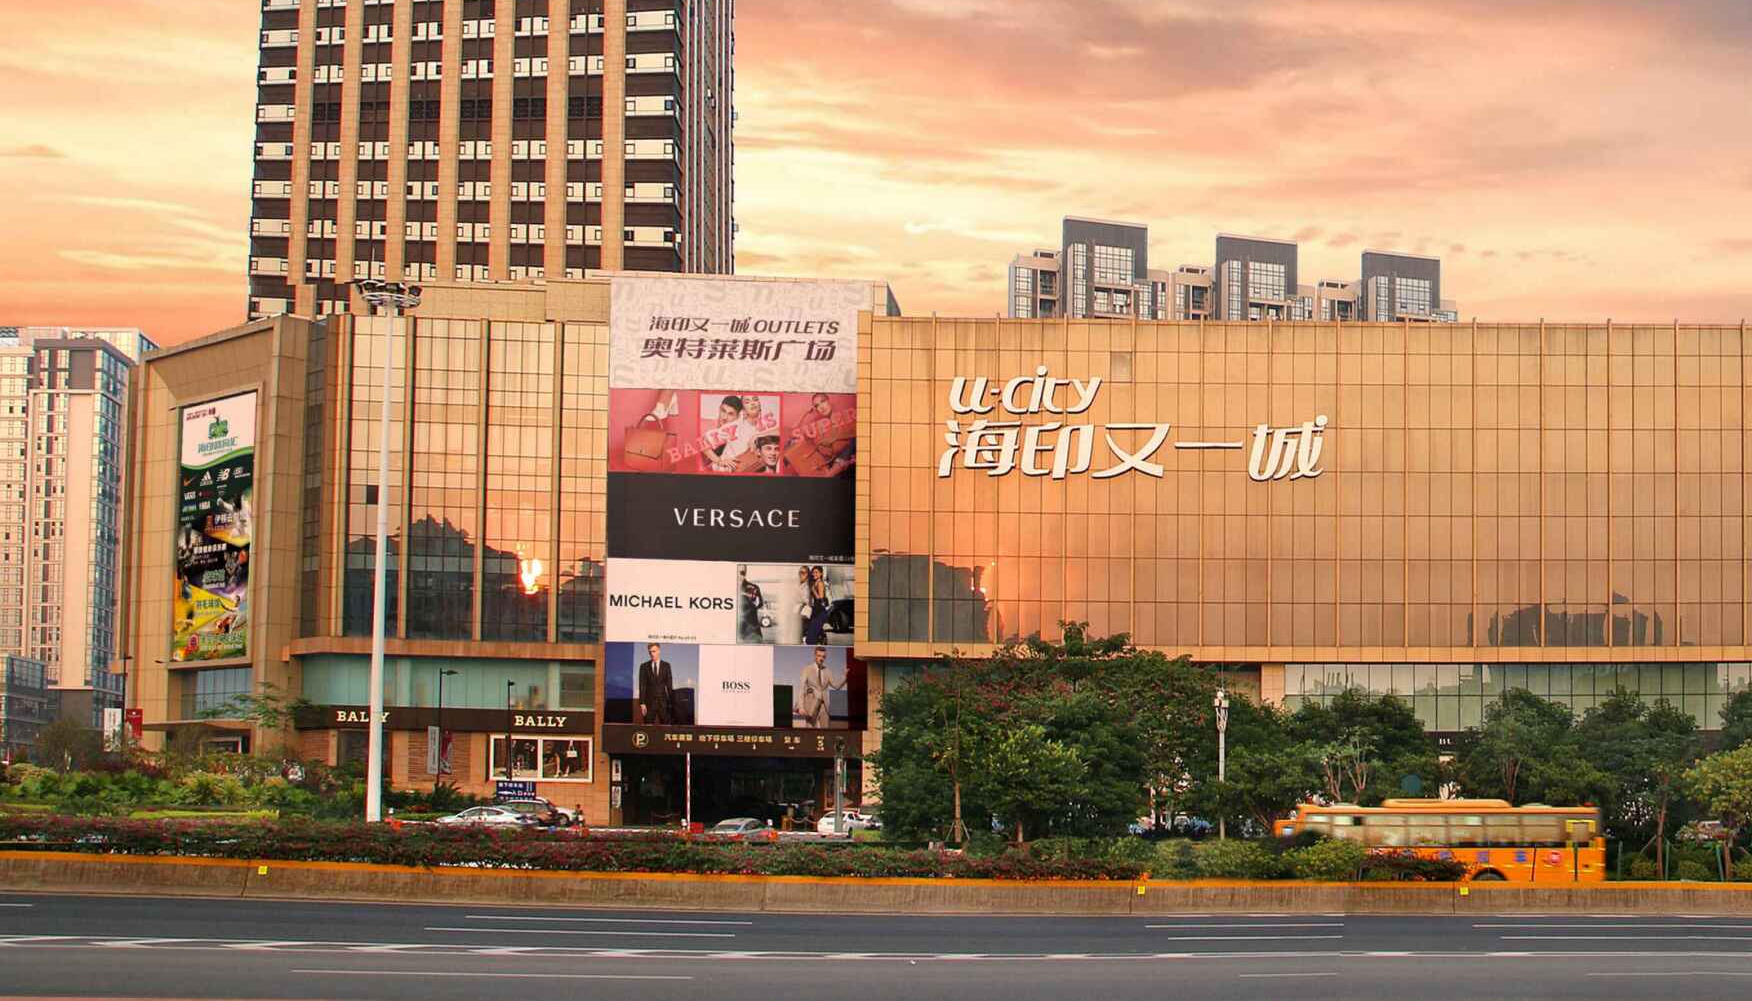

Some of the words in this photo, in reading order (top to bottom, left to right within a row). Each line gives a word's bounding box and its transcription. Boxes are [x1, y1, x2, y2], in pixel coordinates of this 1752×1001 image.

[649, 315, 750, 334] 海印又一城
[753, 319, 840, 335] OUTLETS
[640, 336, 838, 362] 奥特莱斯广场
[791, 407, 858, 442] SUPER
[937, 413, 1330, 482] 海印又一城
[673, 507, 801, 528] VERSACE
[609, 594, 683, 610] MICHAEL
[688, 597, 734, 611] KORS
[721, 680, 751, 691] BOSS
[336, 710, 390, 724] BALY
[514, 714, 568, 728] BALLY
